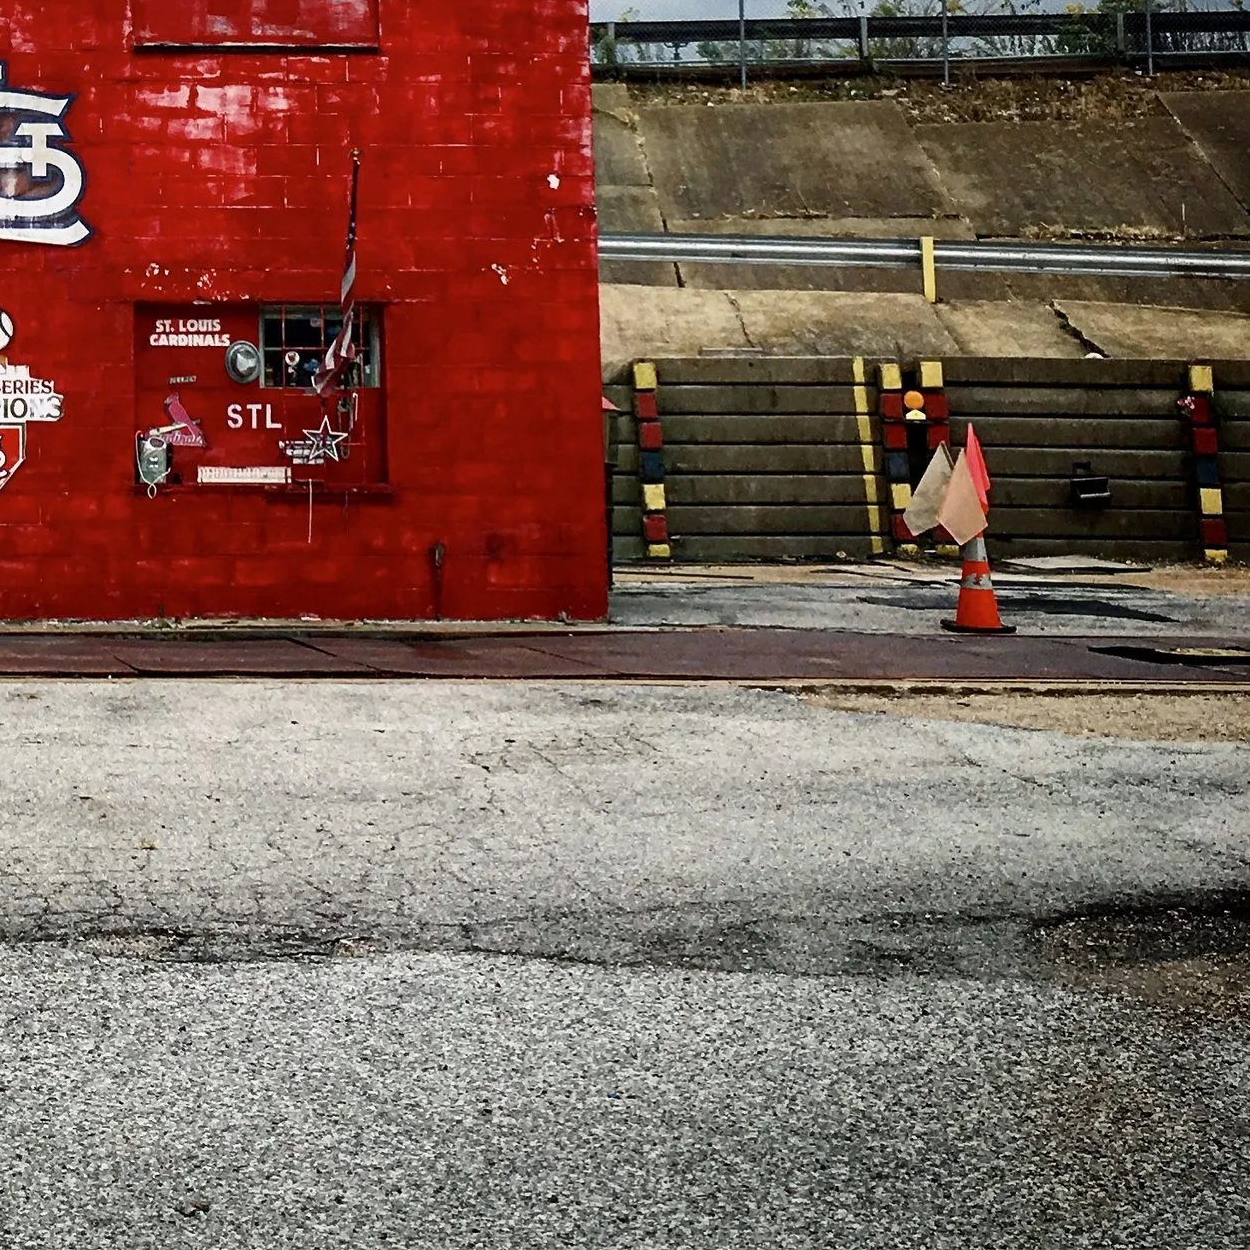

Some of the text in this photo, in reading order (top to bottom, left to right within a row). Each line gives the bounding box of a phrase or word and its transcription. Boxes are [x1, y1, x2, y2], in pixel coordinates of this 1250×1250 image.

[156, 319, 221, 333] ST. LOUIS
[150, 334, 230, 347] CARDINALS
[227, 403, 282, 429] STL
